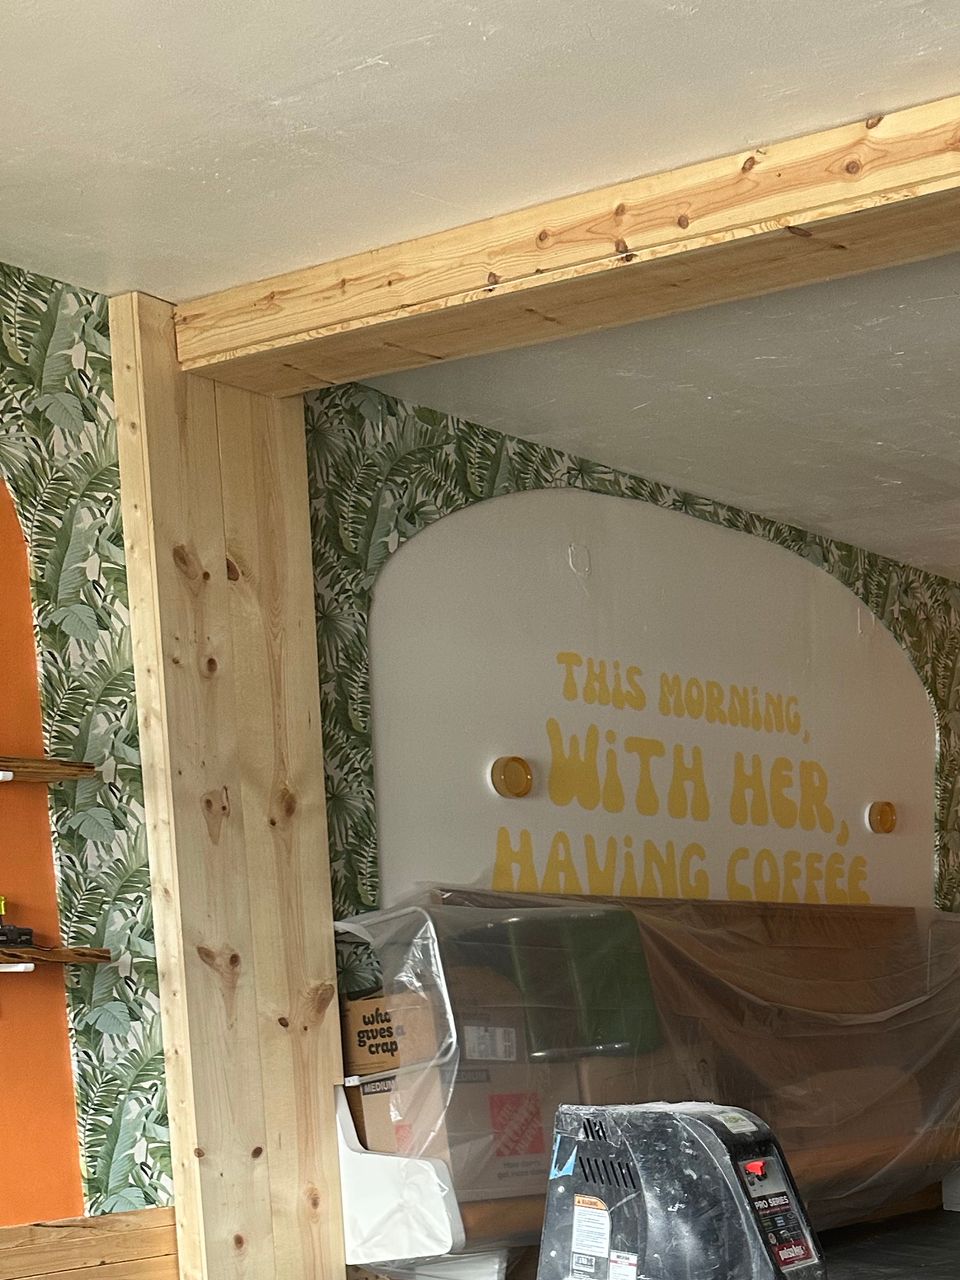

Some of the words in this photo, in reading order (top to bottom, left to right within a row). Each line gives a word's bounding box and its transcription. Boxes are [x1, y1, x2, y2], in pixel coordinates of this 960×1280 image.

[729, 751, 850, 847] HER,
[726, 846, 873, 904] COFFEE
[362, 1007, 392, 1026] who
[357, 1026, 394, 1048] gives
[368, 1040, 399, 1057] crap
[754, 1200, 768, 1210] PRO
